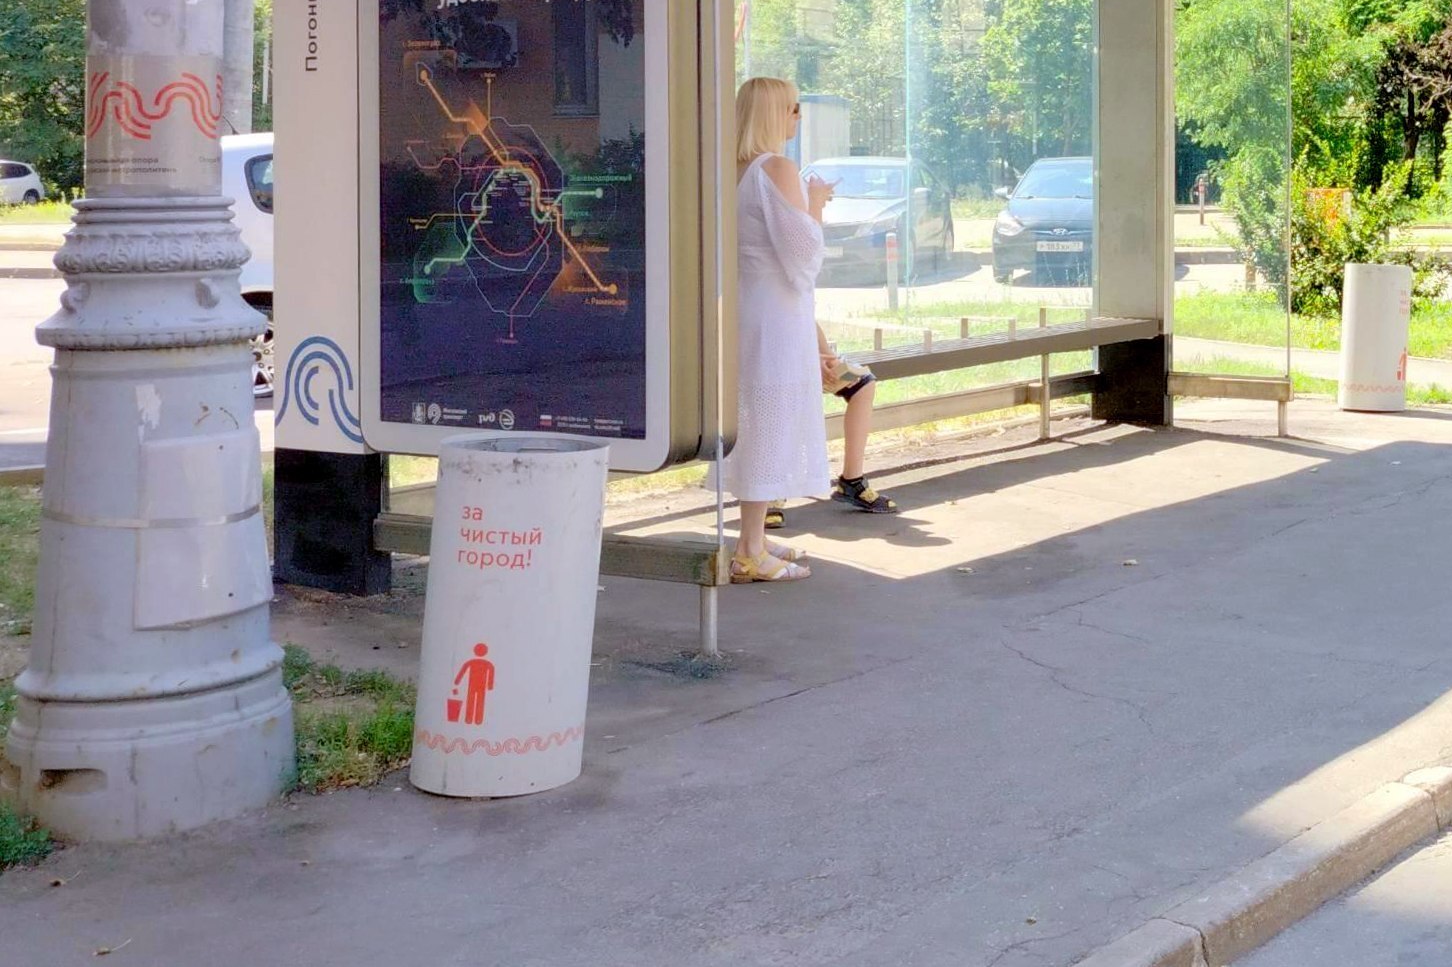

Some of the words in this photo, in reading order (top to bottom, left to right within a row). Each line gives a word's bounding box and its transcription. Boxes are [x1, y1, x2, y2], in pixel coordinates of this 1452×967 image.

[461, 506, 483, 521] за
[460, 527, 542, 545] чистый
[457, 548, 532, 569] город!
